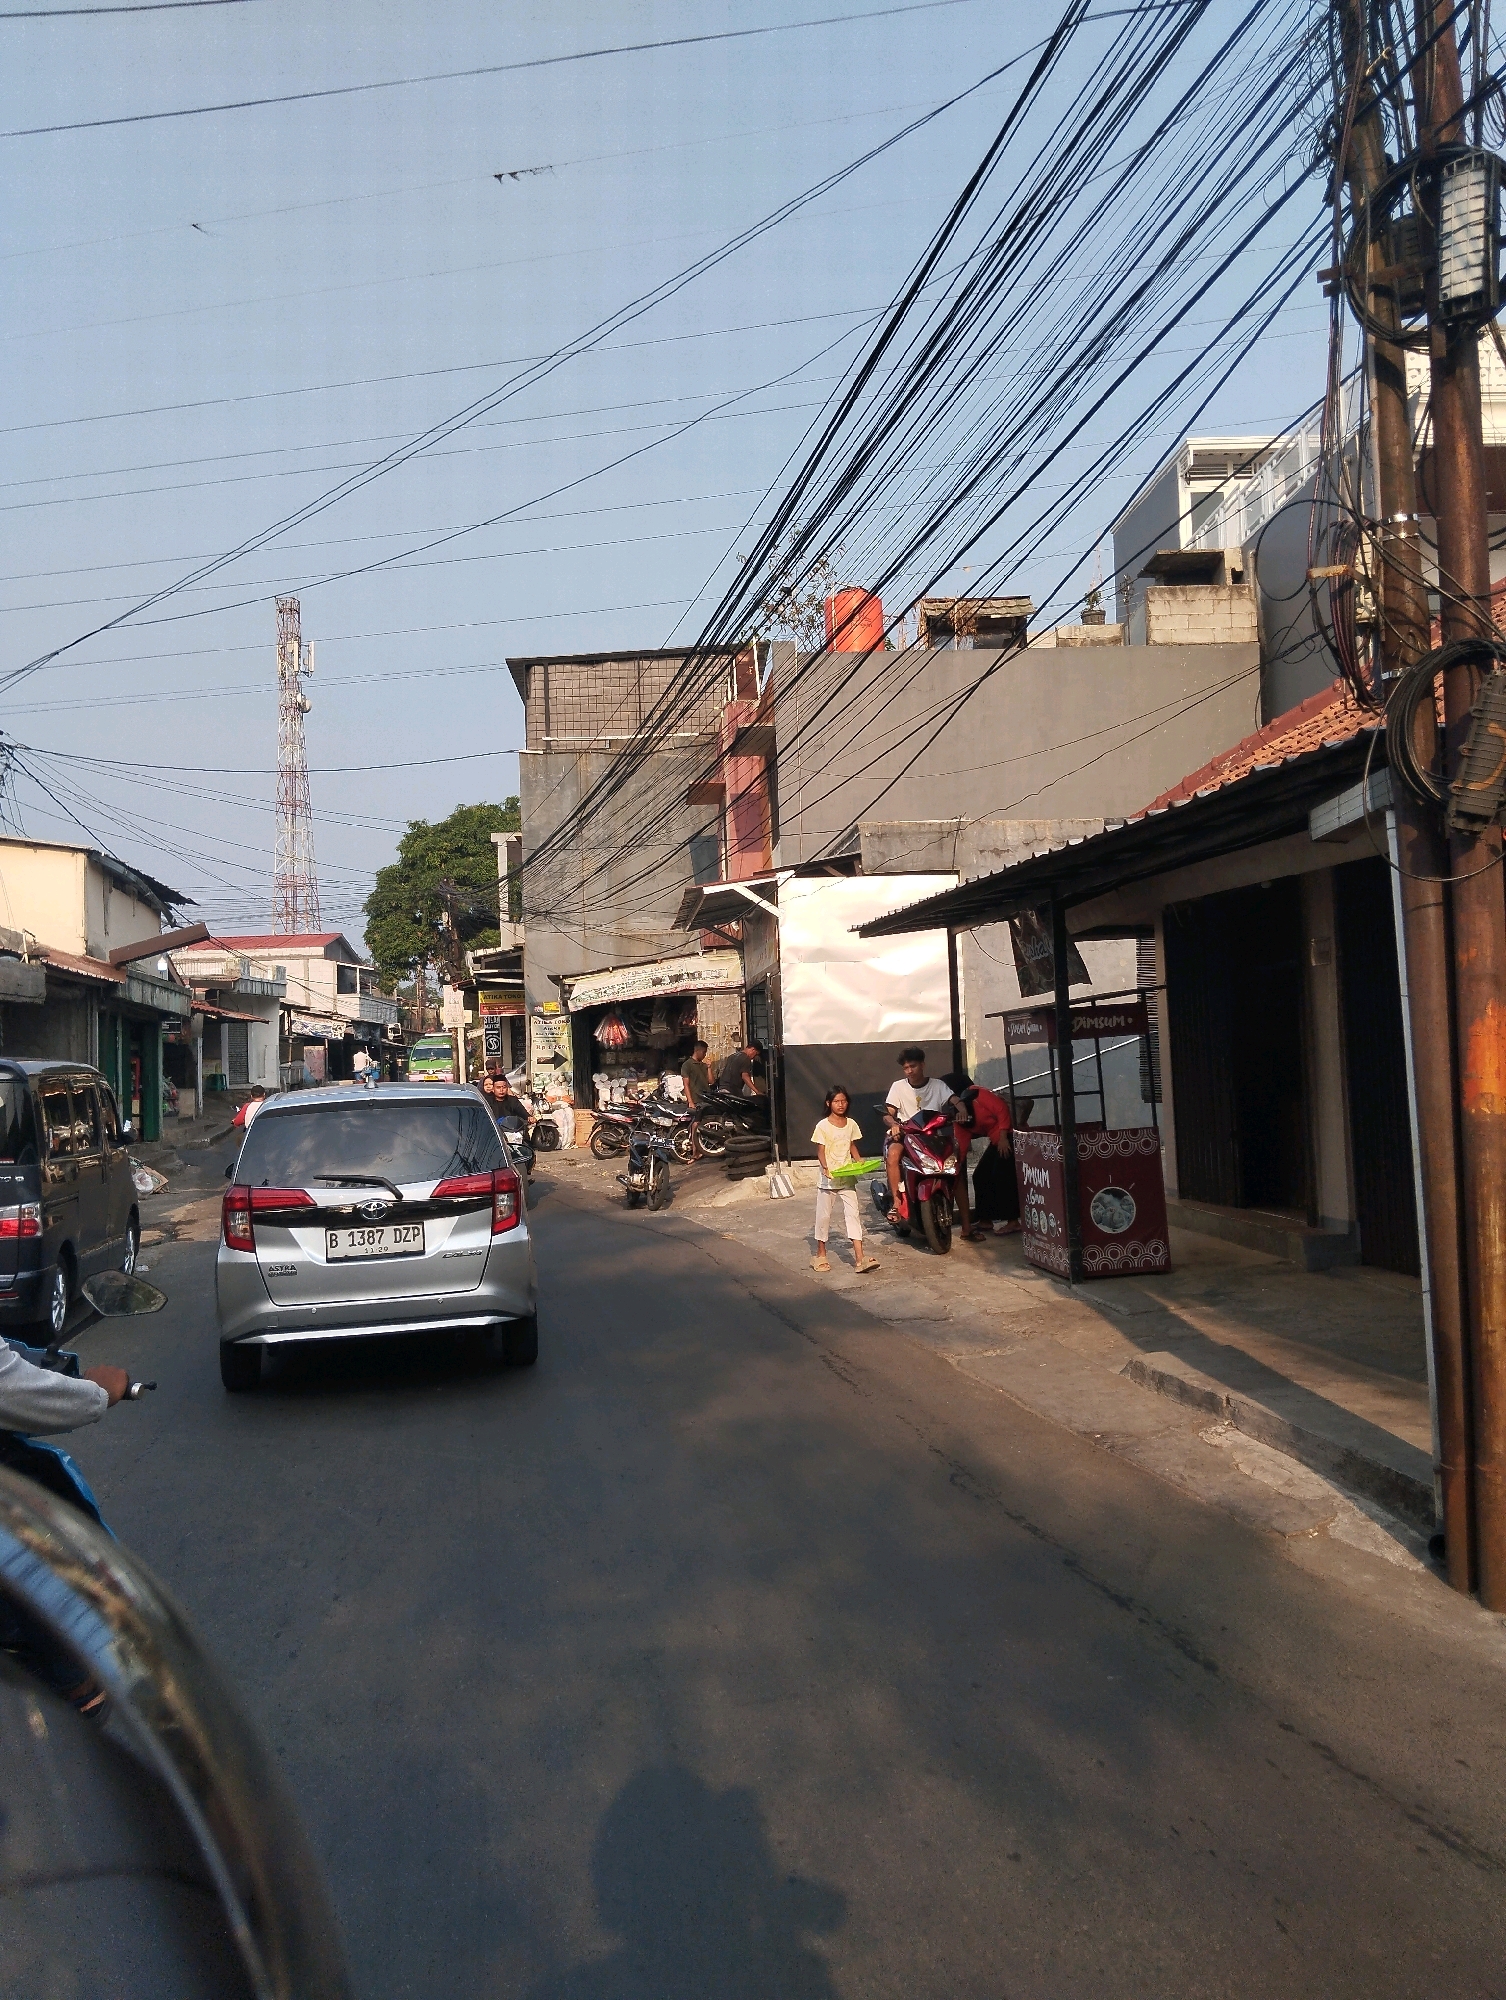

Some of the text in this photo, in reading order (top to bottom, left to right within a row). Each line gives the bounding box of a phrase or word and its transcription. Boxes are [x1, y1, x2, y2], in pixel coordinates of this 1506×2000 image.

[329, 1225, 421, 1249] B 1387 DZP
